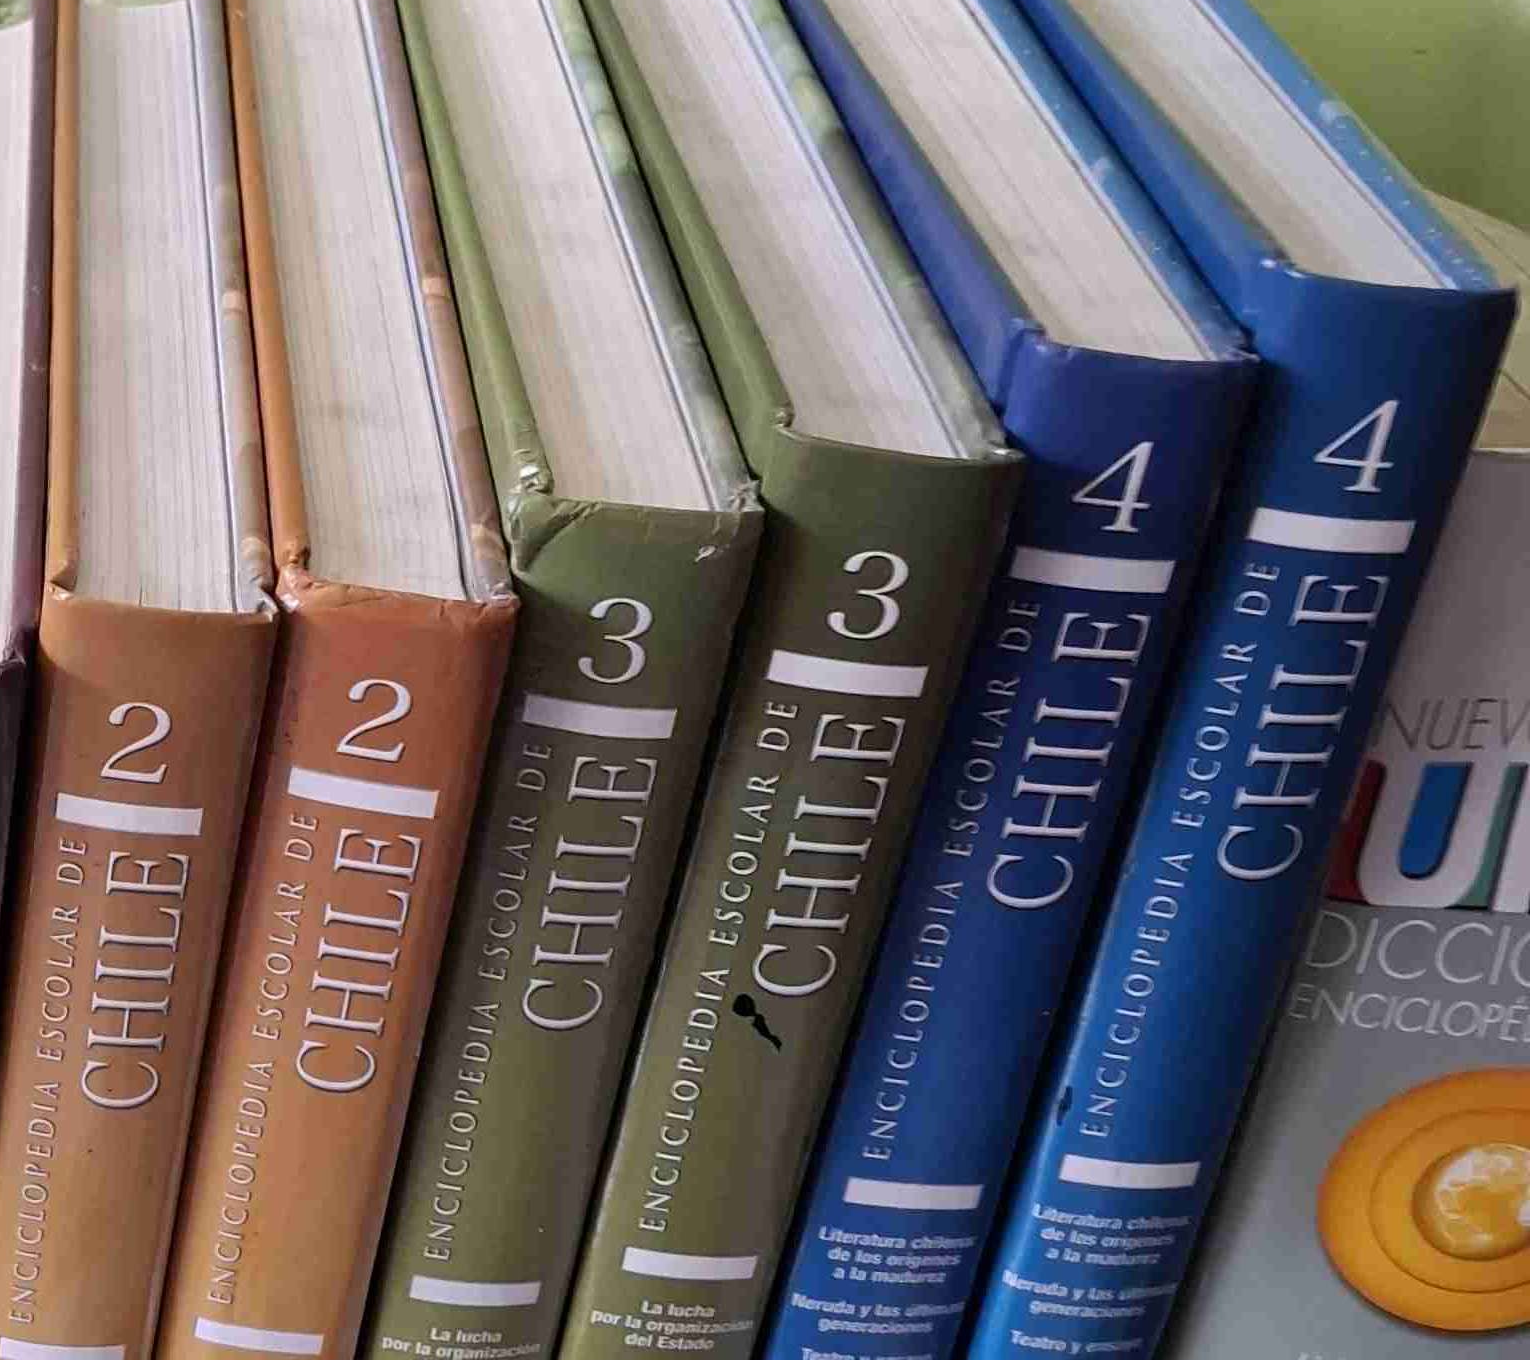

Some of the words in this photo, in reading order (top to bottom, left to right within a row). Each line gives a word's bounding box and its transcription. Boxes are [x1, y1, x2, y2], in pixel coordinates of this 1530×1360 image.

[1072, 441, 1156, 533] 4
[1314, 399, 1399, 493] 4
[335, 679, 412, 762] 2
[578, 597, 655, 683] 3
[826, 551, 909, 639] 3
[100, 701, 171, 784] 2
[987, 612, 1150, 909] CHILE
[1080, 853, 1194, 1137] ENCICLOPEDIA
[1172, 640, 1259, 830] ESCOLAR
[1236, 561, 1281, 617] DE
[1217, 573, 1389, 882] CHILE
[57, 837, 88, 885] DE
[81, 849, 190, 1109] CHILE
[296, 828, 421, 1094] CHILE
[521, 756, 657, 1030] CHILE
[638, 966, 732, 1232] ENCICLOPEDIA
[708, 775, 779, 947] ESCOLAR
[758, 702, 798, 752] DE
[752, 713, 906, 997] CHILE
[863, 881, 964, 1161] ENCICLOPEDIA
[946, 676, 1019, 857] ESCOLAR
[999, 600, 1040, 654] DE
[35, 904, 82, 1062] ESCOLAR
[208, 1058, 275, 1305] ENCICLOPEDIA
[252, 881, 307, 1041] ESCOLAR
[285, 812, 319, 861] DE
[423, 1000, 500, 1262] ENCICLOPEDIA
[479, 815, 538, 981] ESCOLAR
[518, 743, 552, 792] DE
[9, 1079, 62, 1325] ENCICLOPEDIA
[382, 1337, 410, 1350] por
[416, 1343, 430, 1355] la
[436, 1344, 540, 1360] organización
[430, 1328, 450, 1340] La
[457, 1329, 501, 1343] lucha
